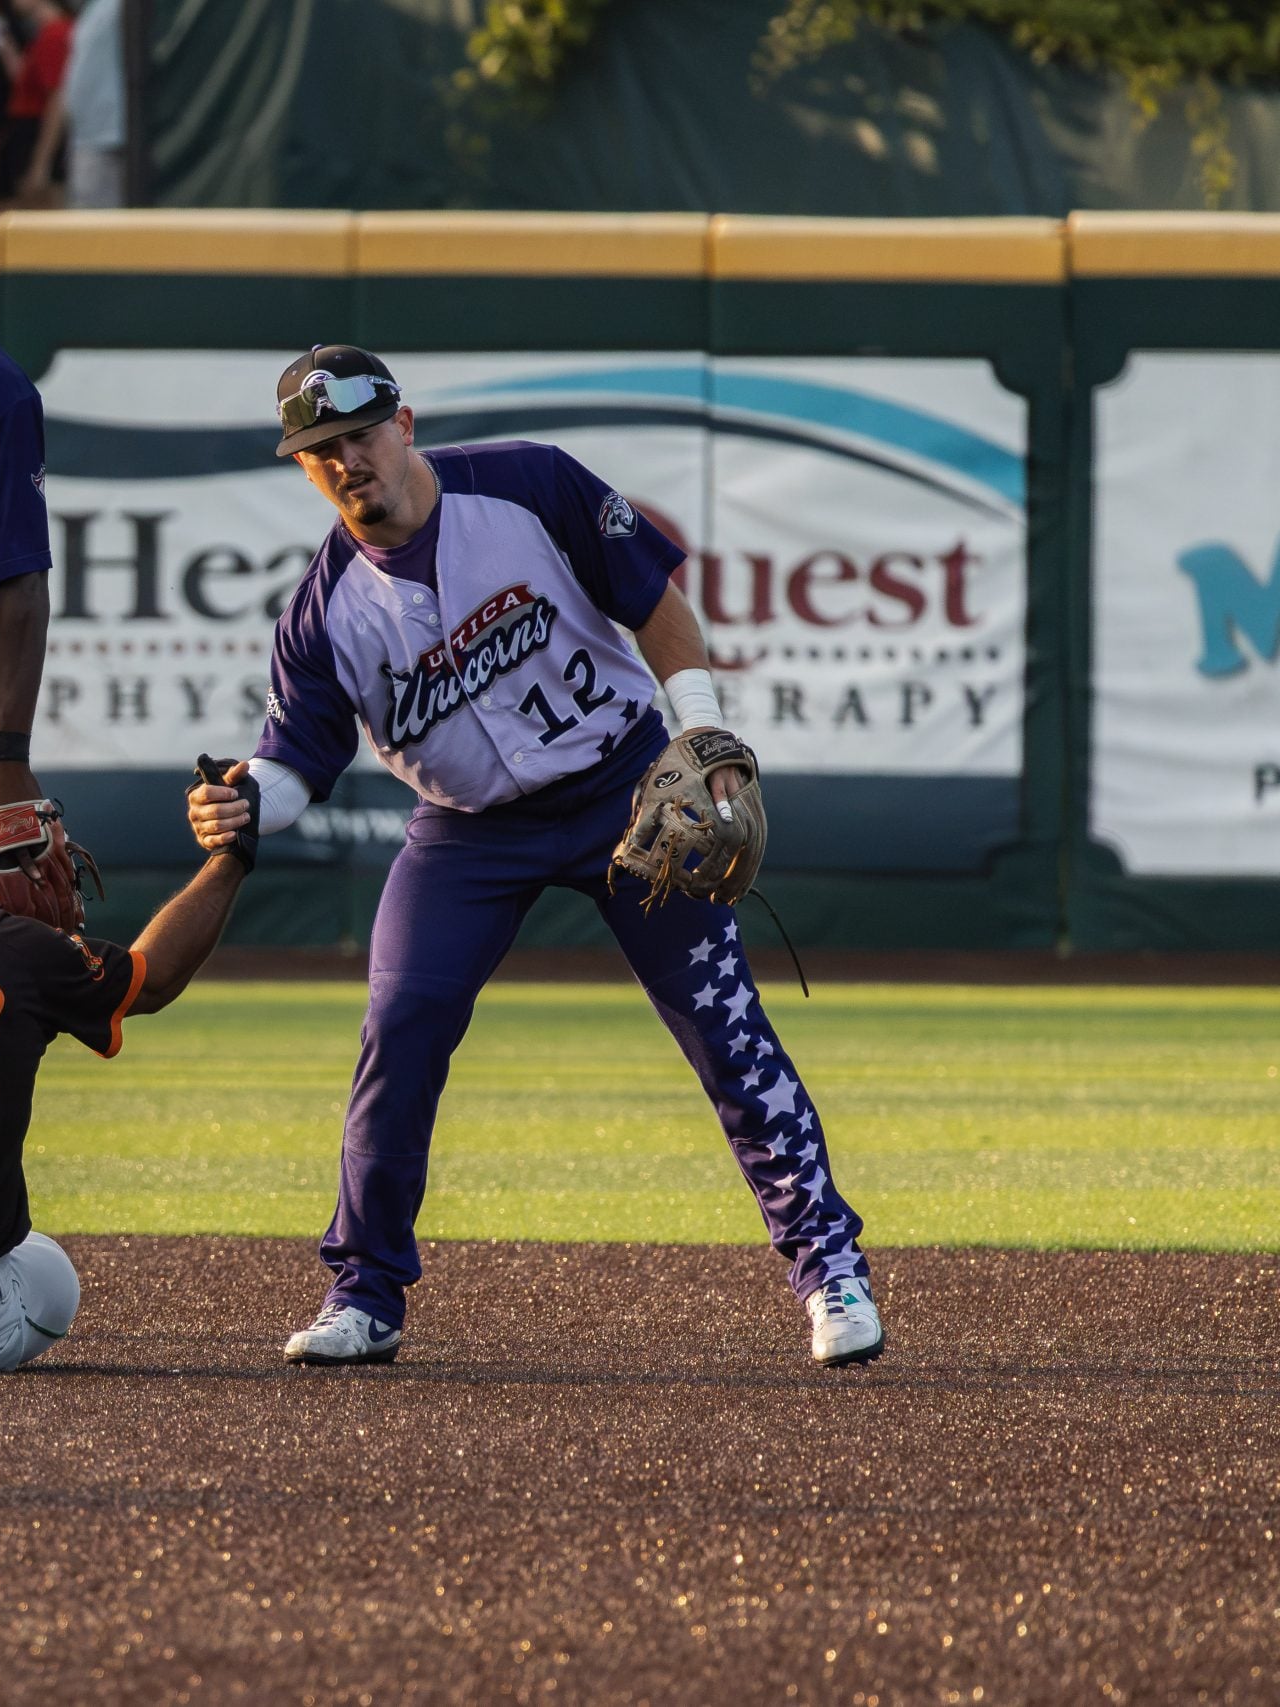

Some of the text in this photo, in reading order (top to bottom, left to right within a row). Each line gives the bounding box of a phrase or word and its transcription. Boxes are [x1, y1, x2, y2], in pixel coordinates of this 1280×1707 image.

[52, 508, 322, 622] Hea
[384, 602, 554, 744] Unicorns
[428, 592, 521, 668] UTICA
[46, 673, 272, 725] PHYS
[715, 682, 998, 726] ERAPY
[519, 648, 618, 747] 12
